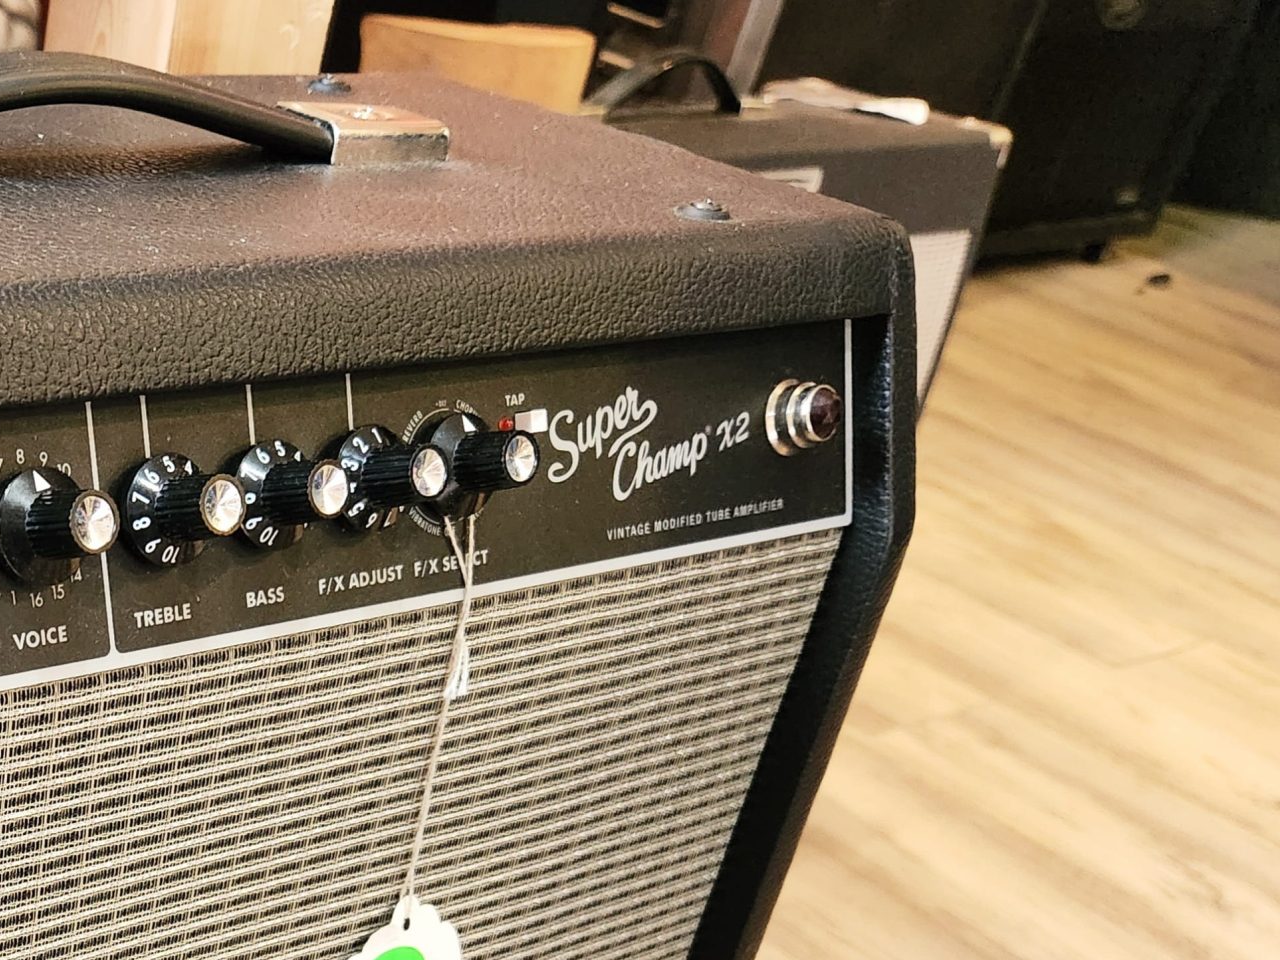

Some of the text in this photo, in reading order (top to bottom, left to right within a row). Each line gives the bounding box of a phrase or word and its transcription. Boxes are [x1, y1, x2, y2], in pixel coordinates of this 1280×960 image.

[505, 394, 525, 406] TAP
[402, 410, 424, 443] REVERB
[548, 386, 657, 483] Super
[274, 440, 286, 457] 5
[352, 437, 369, 454] 2
[16, 449, 25, 464] 8
[38, 451, 48, 467] 9
[57, 463, 72, 477] 10
[162, 455, 176, 473] 5
[341, 459, 359, 471] 3
[610, 433, 707, 501] Champ
[132, 516, 152, 531] 8
[409, 505, 441, 537] VIBRATONE
[607, 499, 784, 541] VINTAGE MODIFIED TUBE AMPLIFIER
[161, 545, 180, 564] 10
[414, 549, 489, 577] F/X SECT
[11, 590, 17, 605] 1
[29, 592, 44, 608] 16
[51, 584, 65, 600] 15
[71, 567, 82, 583] 4
[318, 565, 404, 595] F/X ADJUST
[246, 586, 285, 608] BASS
[134, 603, 192, 628] TREBLE
[13, 625, 69, 651] VOICE
